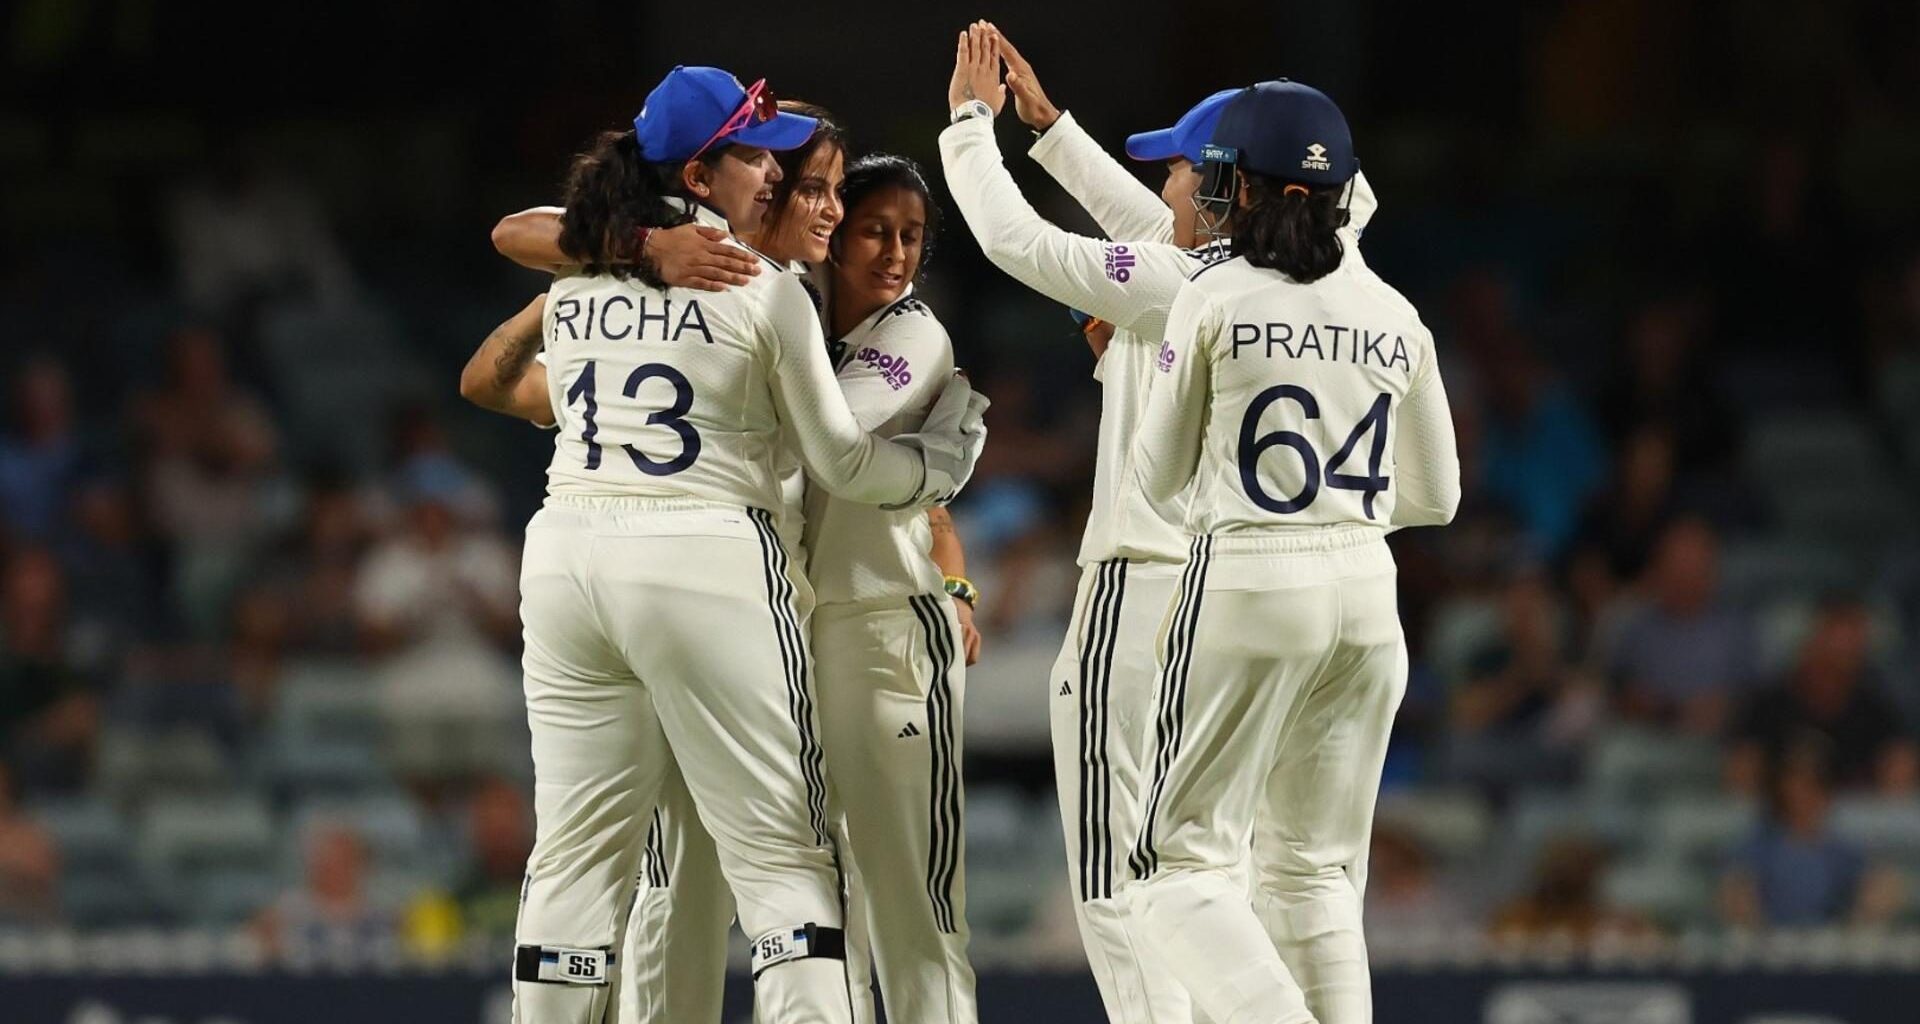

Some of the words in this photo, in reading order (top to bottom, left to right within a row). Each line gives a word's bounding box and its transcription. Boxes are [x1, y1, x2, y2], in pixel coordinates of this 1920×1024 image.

[1301, 160, 1331, 171] SHREY
[1105, 246, 1115, 281] YRES
[1114, 245, 1135, 283] ollo
[555, 296, 714, 343] RICHA
[857, 347, 911, 385] apollo
[1232, 323, 1410, 372] PRATIKA
[567, 361, 701, 476] 13
[1238, 384, 1392, 520] 64
[568, 955, 596, 977] SS
[762, 935, 783, 960] SS
